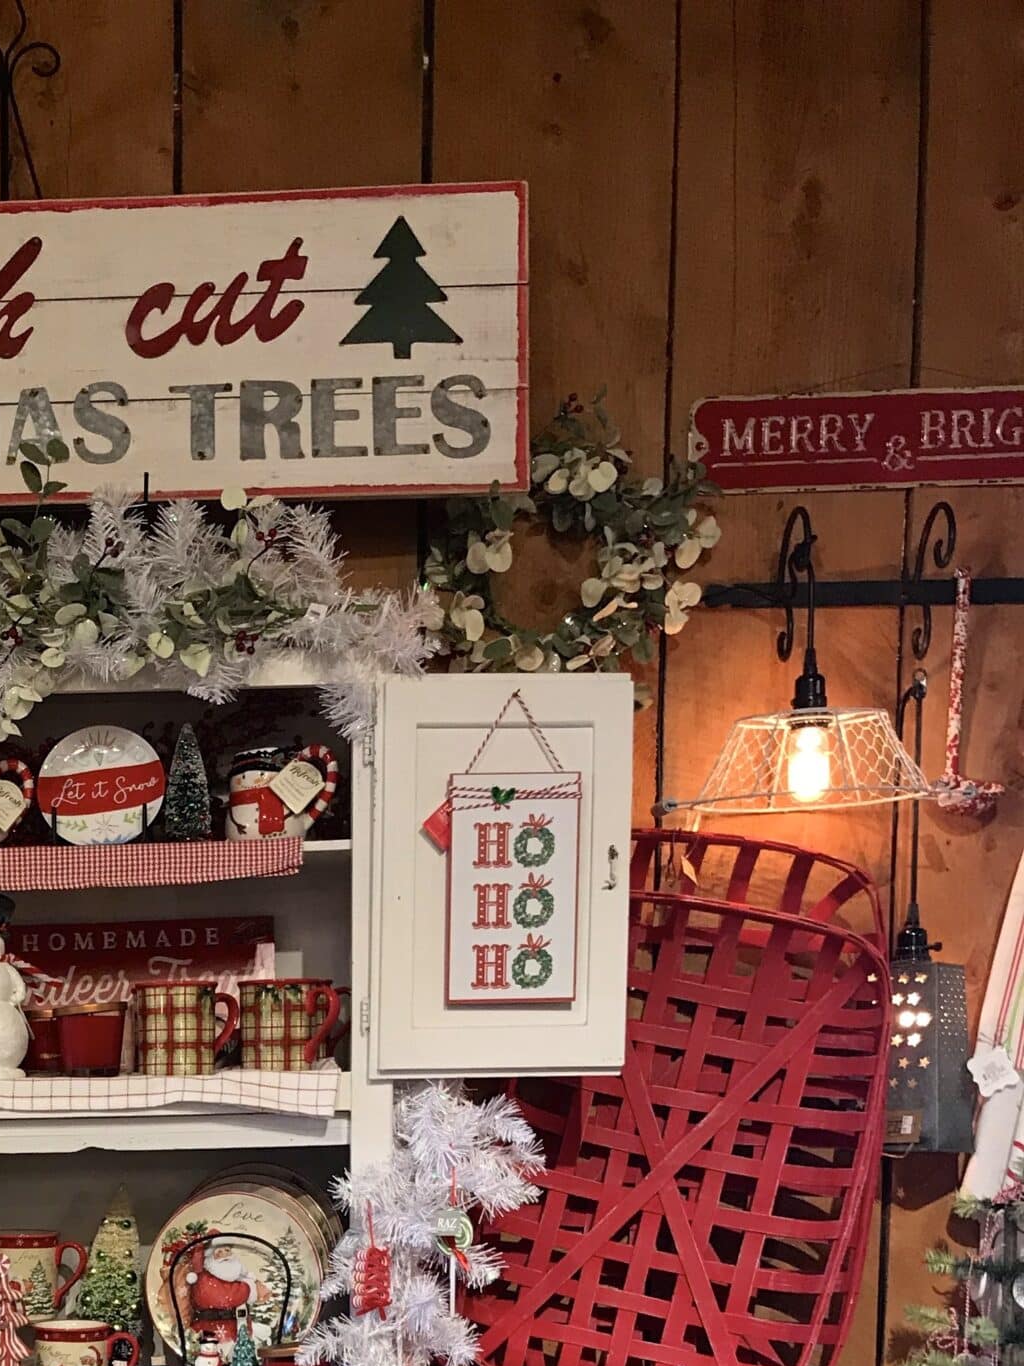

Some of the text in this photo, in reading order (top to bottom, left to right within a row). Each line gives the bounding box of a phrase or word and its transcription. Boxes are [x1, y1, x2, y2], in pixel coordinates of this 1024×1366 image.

[126, 236, 308, 358] cut
[168, 374, 491, 463] TREES
[720, 407, 1024, 471] MERRY & BRIG
[51, 776, 160, 808] Let it Snow
[22, 928, 220, 952] HOMEMADE
